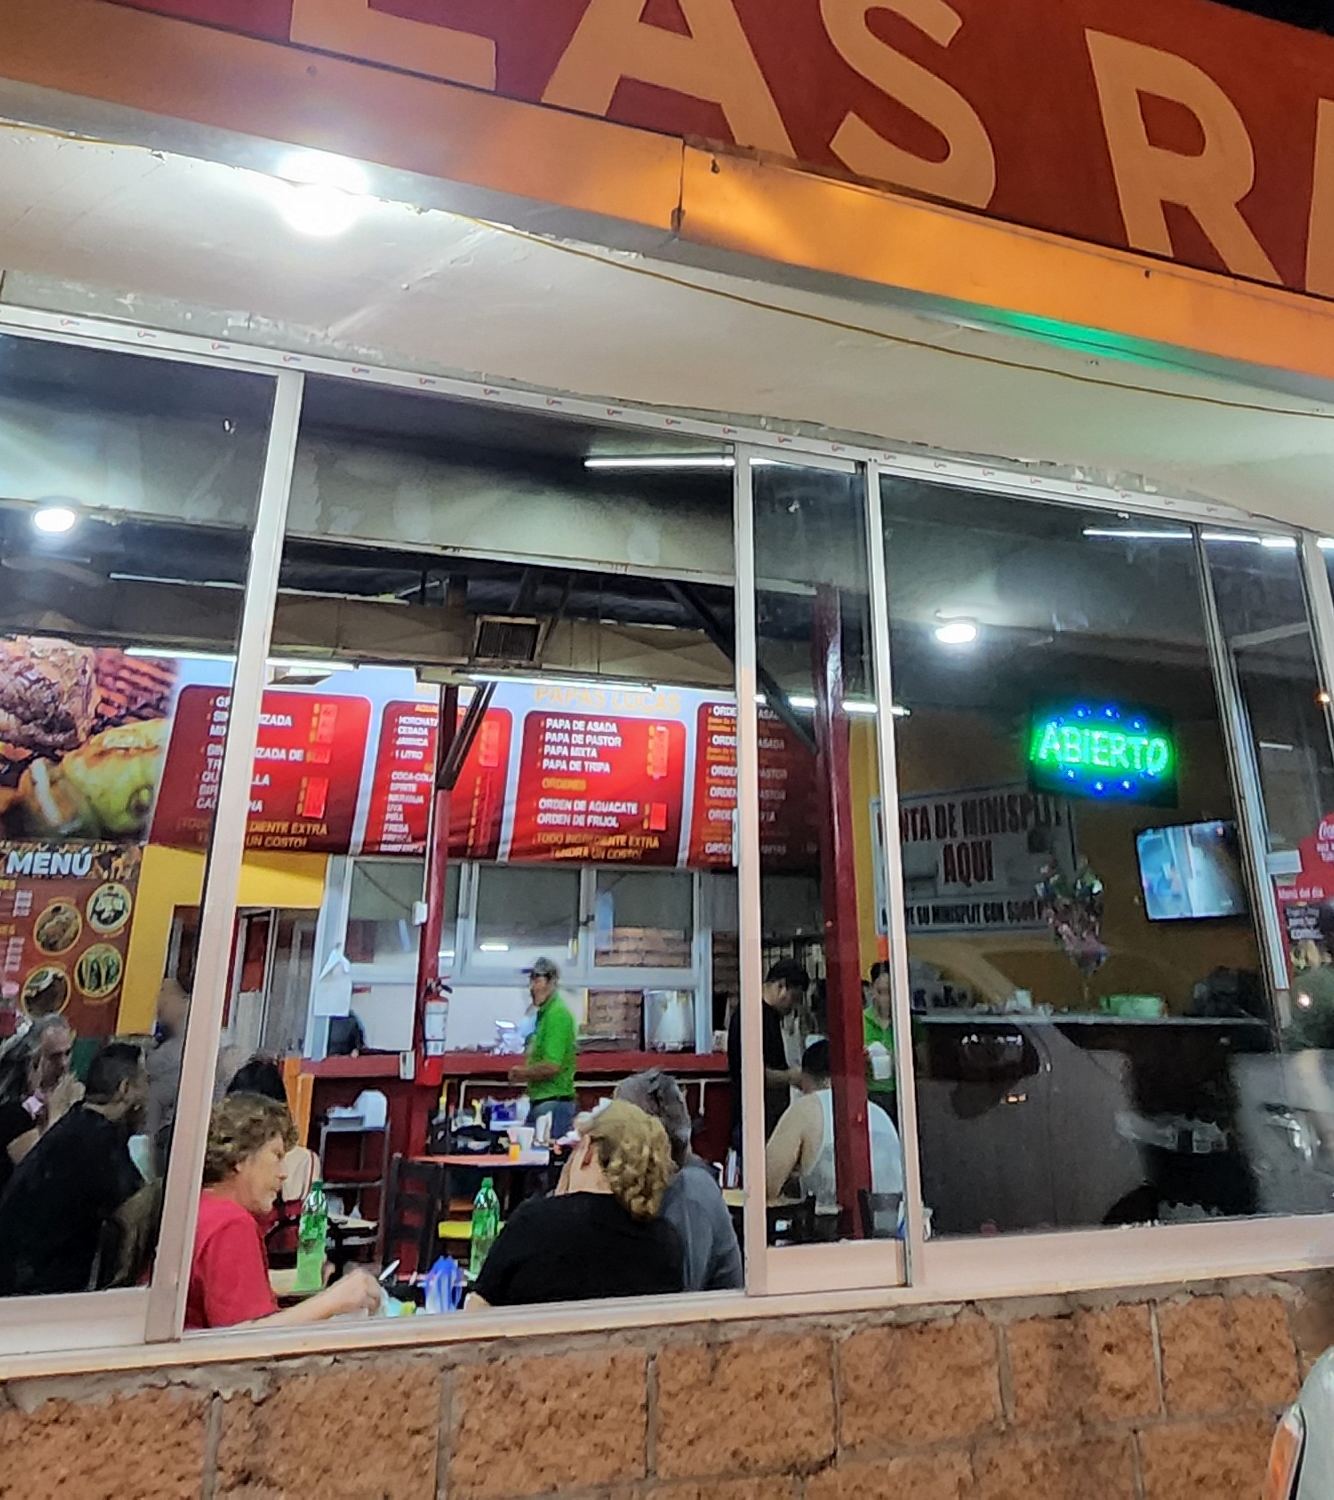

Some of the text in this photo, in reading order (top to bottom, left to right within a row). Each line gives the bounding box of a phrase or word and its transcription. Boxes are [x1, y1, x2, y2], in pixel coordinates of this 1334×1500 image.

[534, 686, 682, 714] PAPAS LUCAS
[713, 705, 737, 717] ORDE
[545, 717, 618, 733] PAPA DE ASADA
[544, 732, 623, 747] PAPA DE PASTOR
[712, 735, 737, 746] ORDE
[543, 745, 598, 758] PAPA MIXTA
[1039, 723, 1168, 773] ABIERTO
[542, 759, 611, 773] PAPA DE TRIPA
[759, 768, 787, 779] ASTOR
[759, 789, 787, 801] ASTOR
[538, 798, 638, 814] ORDEN DE AGUACATE
[536, 813, 619, 828] ORDEN DE FRIJOL
[708, 809, 733, 820] ORDE
[934, 803, 958, 839] DE
[291, 822, 328, 836] EXTRA
[629, 835, 660, 848] EXTRA
[6, 846, 93, 876] MENÚ
[943, 840, 995, 887] AQUI
